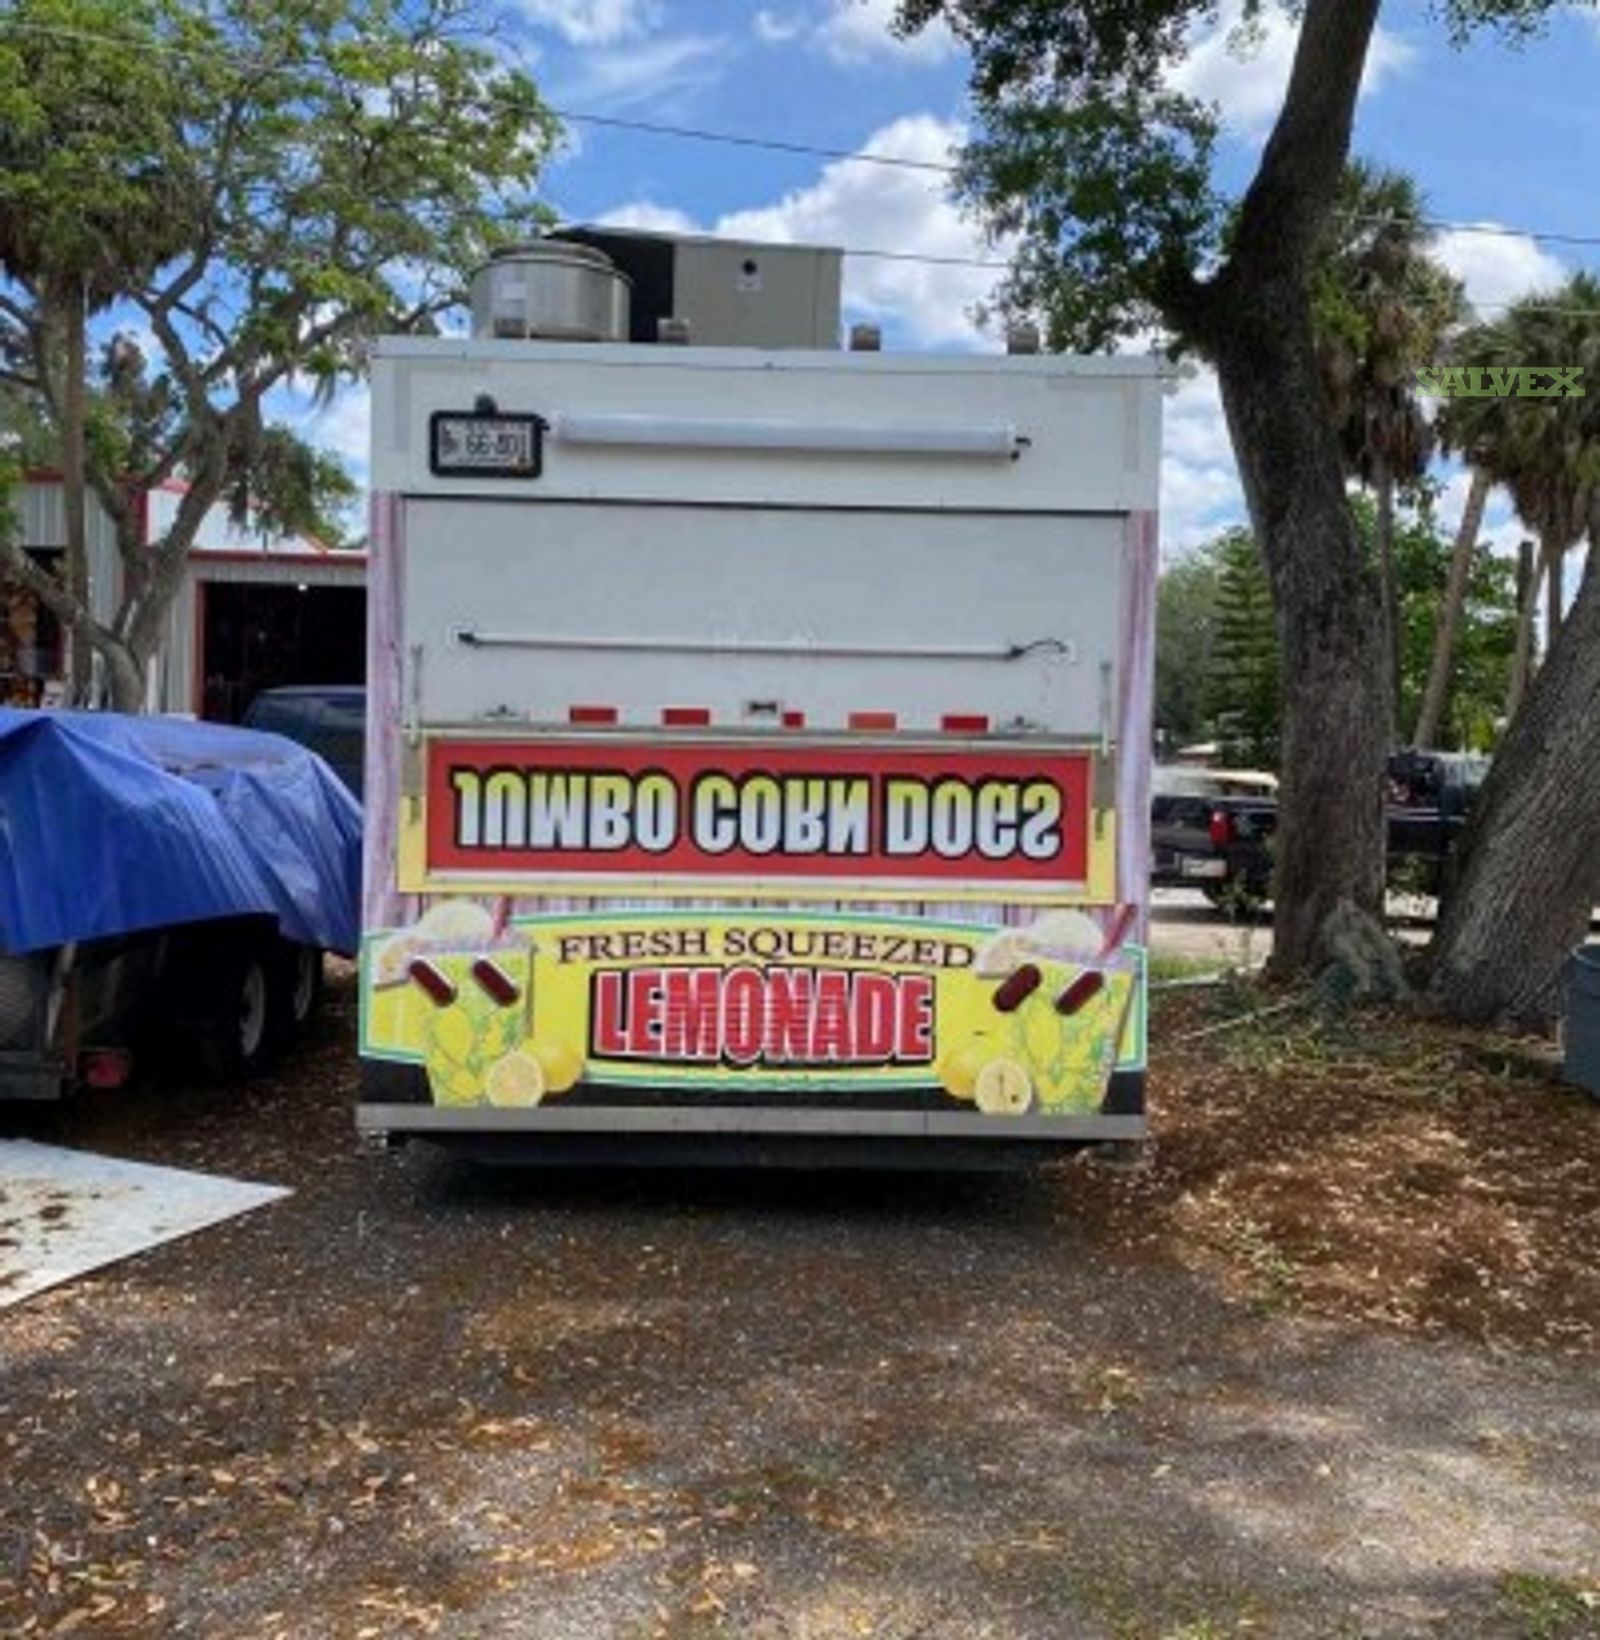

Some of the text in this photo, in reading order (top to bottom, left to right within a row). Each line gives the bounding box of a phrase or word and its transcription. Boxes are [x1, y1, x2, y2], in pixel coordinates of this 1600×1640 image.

[557, 926, 976, 968] FRESH SQUEEZED
[590, 964, 935, 1068] LEMONADE
